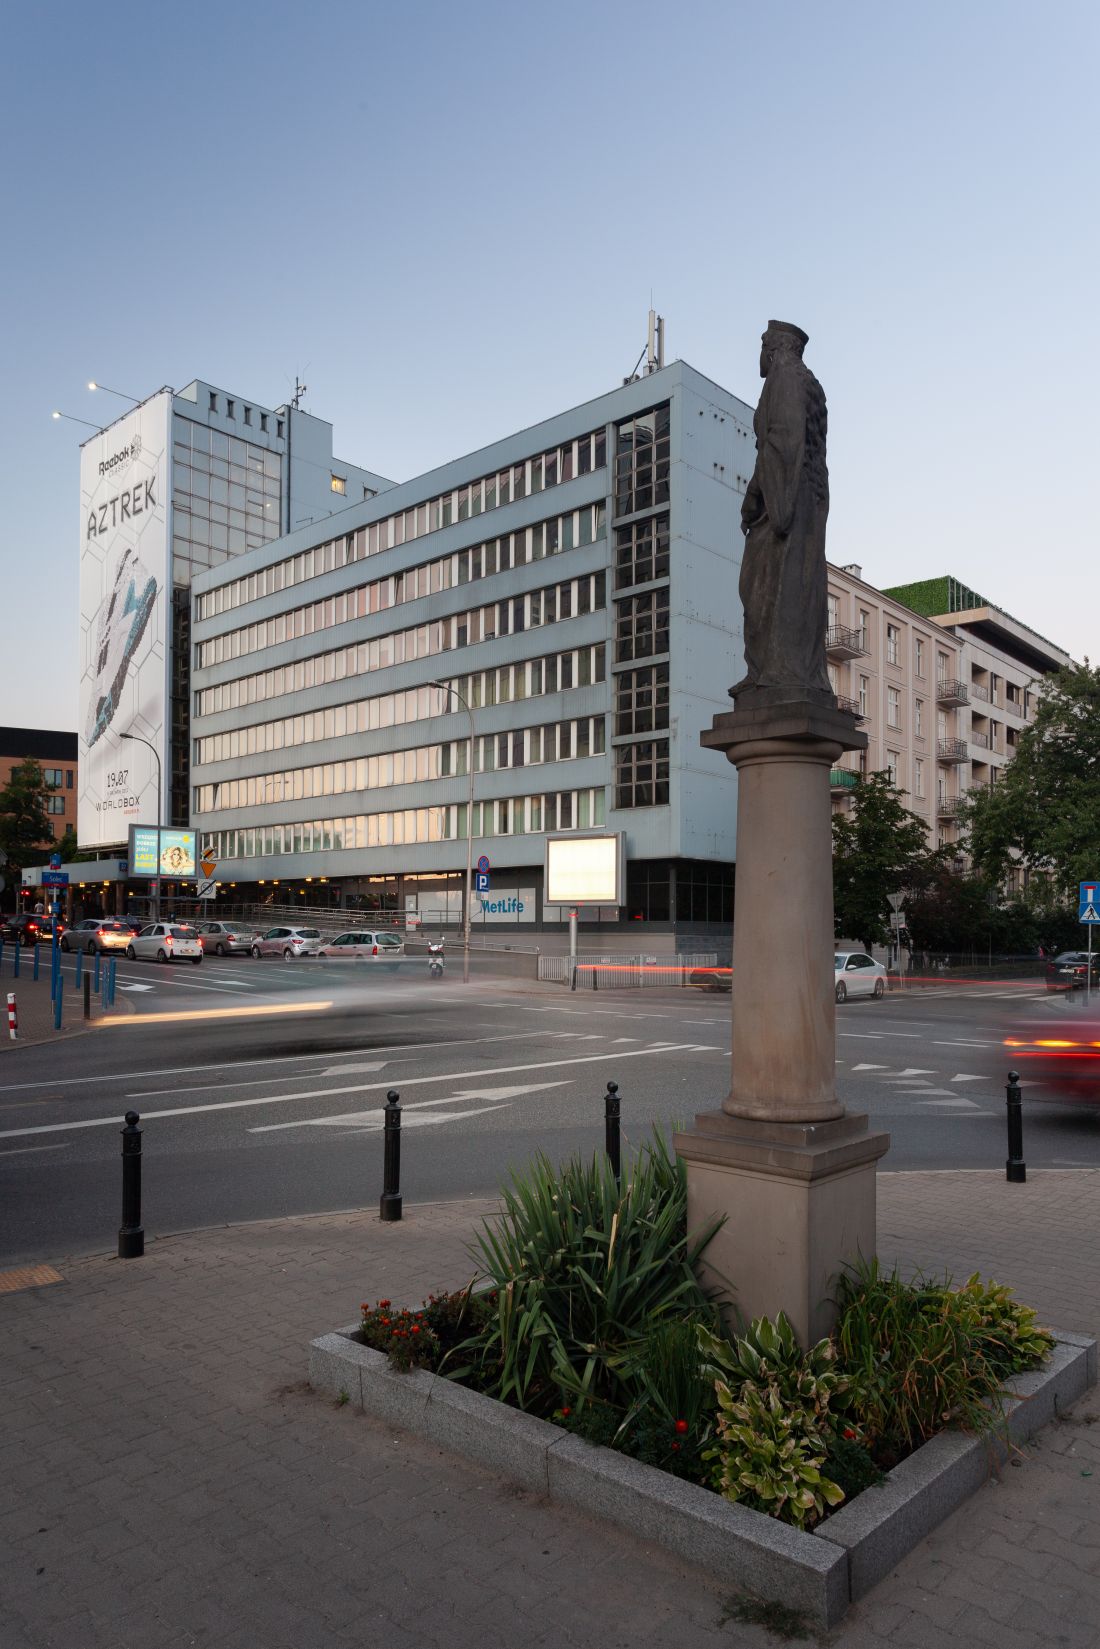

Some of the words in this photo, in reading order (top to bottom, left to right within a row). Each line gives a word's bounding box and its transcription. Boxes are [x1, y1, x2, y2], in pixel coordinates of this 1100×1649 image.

[98, 446, 130, 476] Reebok
[87, 475, 156, 540] AZTREK
[479, 875, 487, 890] P
[479, 897, 524, 914] MetLife
